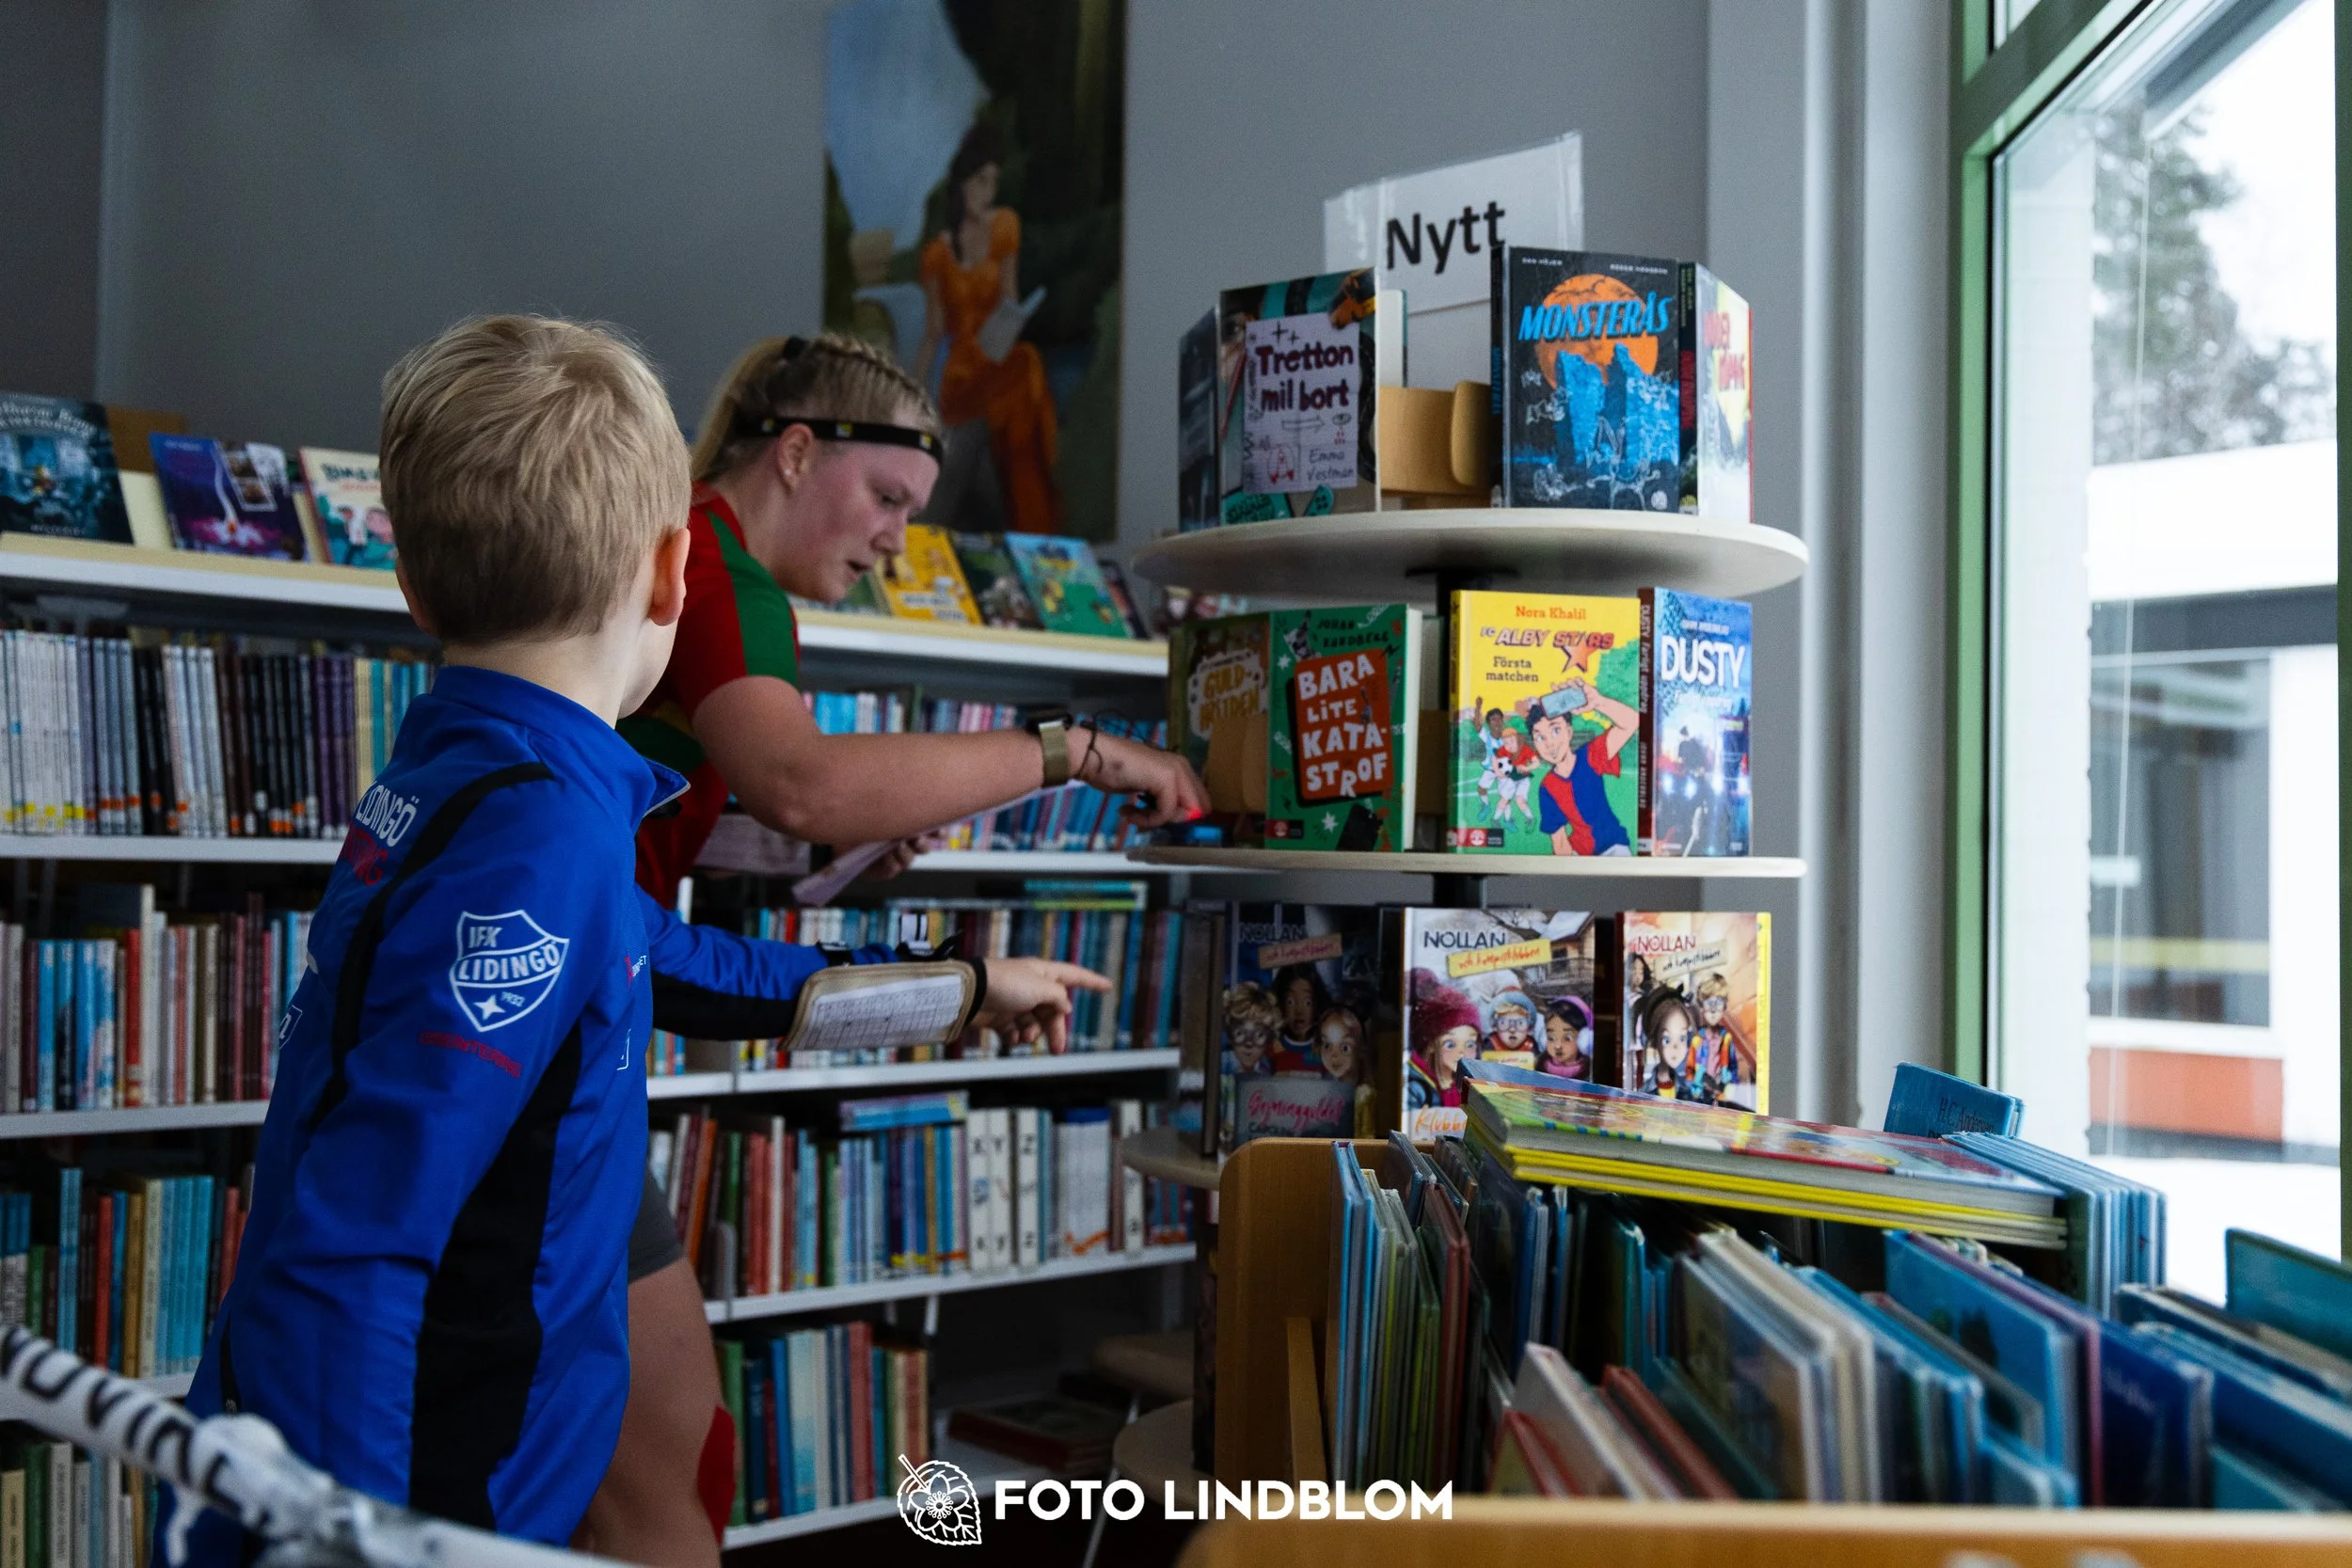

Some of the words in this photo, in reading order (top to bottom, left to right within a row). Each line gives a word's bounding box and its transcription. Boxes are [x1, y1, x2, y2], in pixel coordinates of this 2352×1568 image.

[1386, 200, 1505, 275] Nytt
[1518, 290, 1673, 341] MONSTERÅS
[1255, 341, 1355, 376] Tretton
[1261, 378, 1294, 412] mil
[1298, 378, 1350, 412] bort
[1515, 606, 1547, 619] Nora
[1549, 607, 1587, 621] Khalil
[1496, 627, 1550, 647] ALBY
[1297, 655, 1376, 701] BARA
[1486, 672, 1539, 683] matchen
[1493, 656, 1532, 669] Första
[1661, 634, 1746, 689] DUSTY
[1301, 721, 1388, 760] KATA-
[1306, 752, 1388, 798] STROF
[469, 927, 503, 949] IFK
[1423, 930, 1506, 950] NOLLAN
[1637, 935, 1697, 952] NOLLAN
[457, 942, 561, 981] LIDINGÖ
